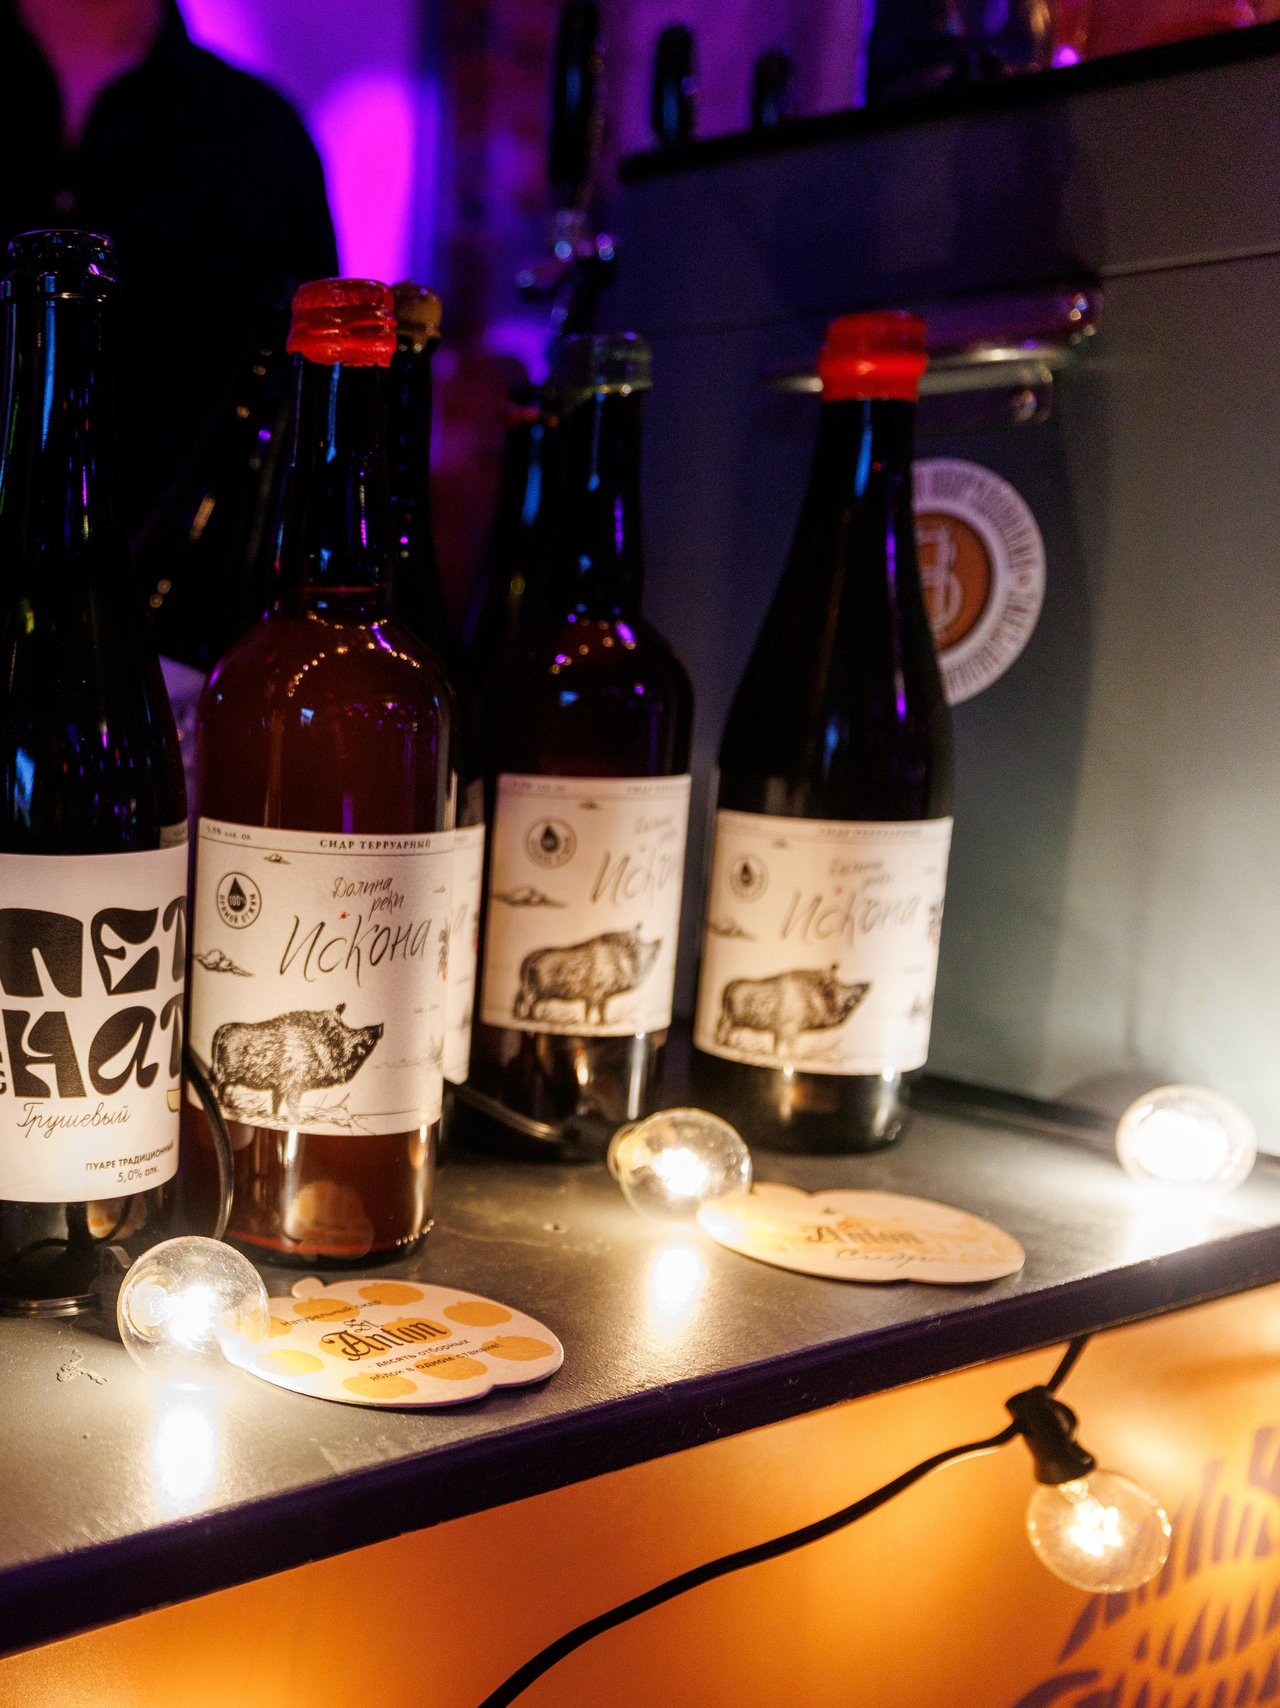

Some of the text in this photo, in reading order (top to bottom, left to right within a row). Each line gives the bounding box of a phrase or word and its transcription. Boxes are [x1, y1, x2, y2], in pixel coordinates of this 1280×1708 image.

[320, 838, 431, 850] СИДР ТЕРРУАРНЫЙ
[332, 875, 394, 899] Долина
[368, 890, 405, 922] реки
[280, 915, 432, 989] Искона
[17, 1102, 132, 1139] Грушевый
[85, 1160, 116, 1172] ПУАРЕ
[117, 1165, 160, 1183] 5,0% алк.
[280, 1306, 354, 1327] Натуральный
[320, 1322, 447, 1362] Anton
[376, 1354, 417, 1368] десять
[417, 1339, 472, 1356] отборных
[369, 1369, 405, 1382] яблок
[415, 1356, 456, 1370] одном
